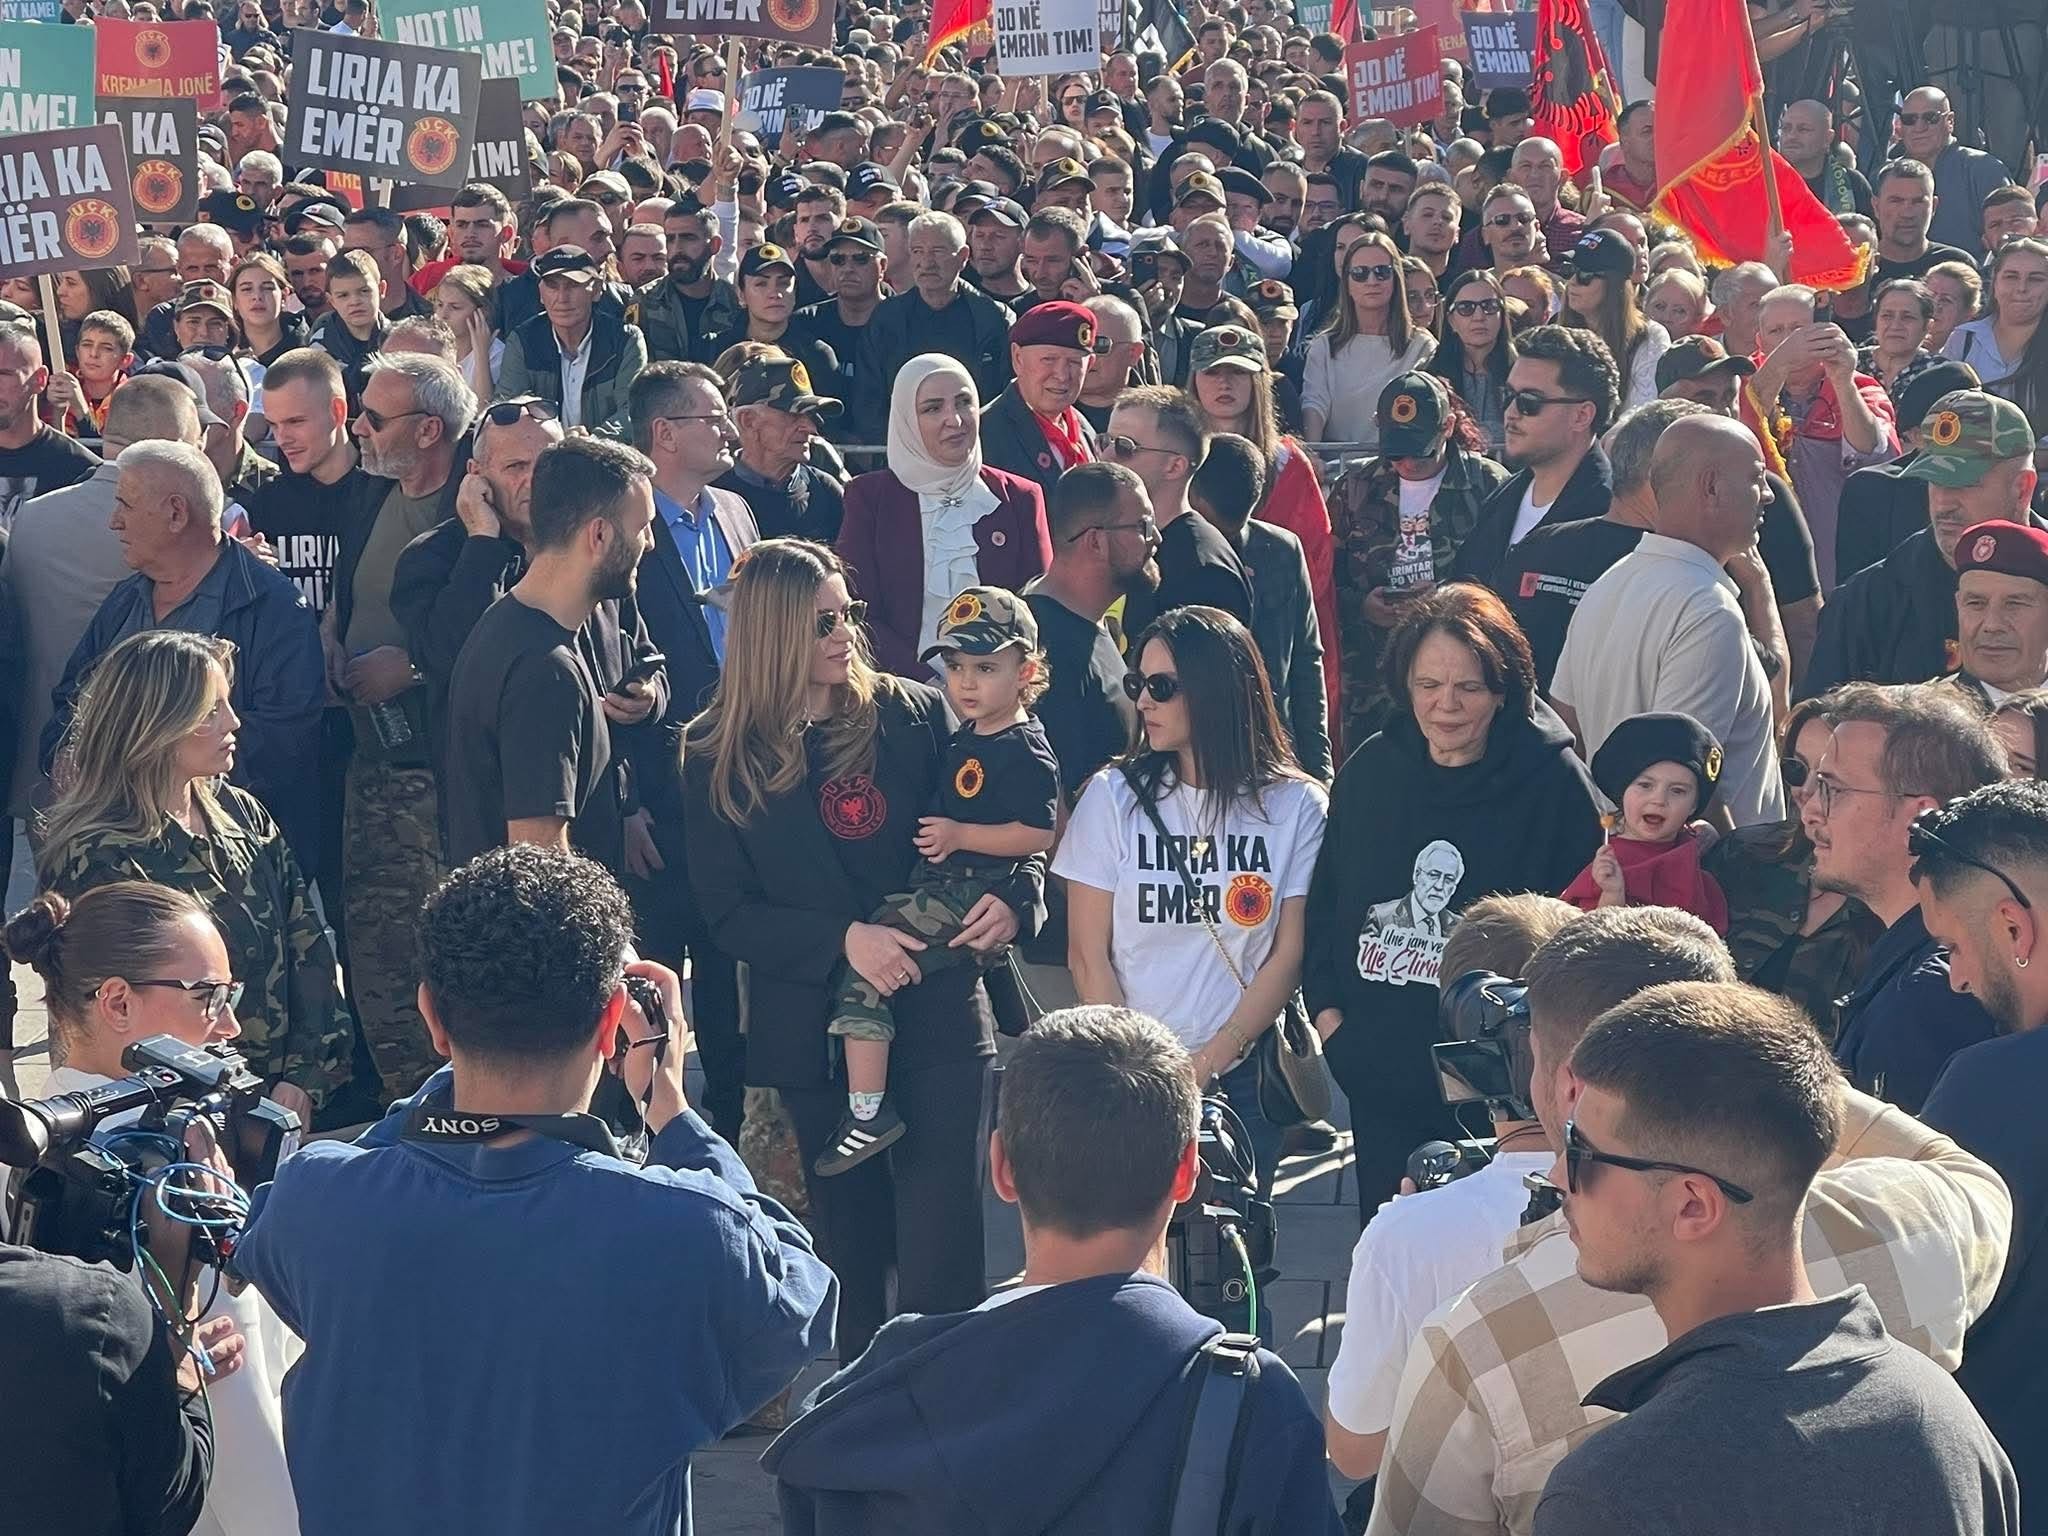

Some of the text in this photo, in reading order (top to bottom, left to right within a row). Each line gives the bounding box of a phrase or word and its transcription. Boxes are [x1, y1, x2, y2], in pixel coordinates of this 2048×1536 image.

[395, 5, 484, 48] NOT IN
[998, 0, 1041, 31] JO NË
[1471, 21, 1519, 49] JO NË
[1000, 28, 1094, 58] EMRIN TIM!
[1474, 50, 1531, 73] EMRIN
[178, 72, 215, 96] JONË
[307, 48, 461, 115] LIRIA KA
[1354, 46, 1406, 89] JO NË
[0, 91, 77, 132] AME!
[763, 77, 788, 107] NË
[1355, 70, 1440, 118] EMRIN TIM!
[132, 111, 181, 156] KA
[301, 104, 404, 166] EMËR
[52, 144, 113, 196] KA
[1227, 833, 1272, 873] KA
[1407, 932, 1429, 950] jam
[1431, 941, 1444, 954] ve
[421, 1117, 500, 1134] SONY
